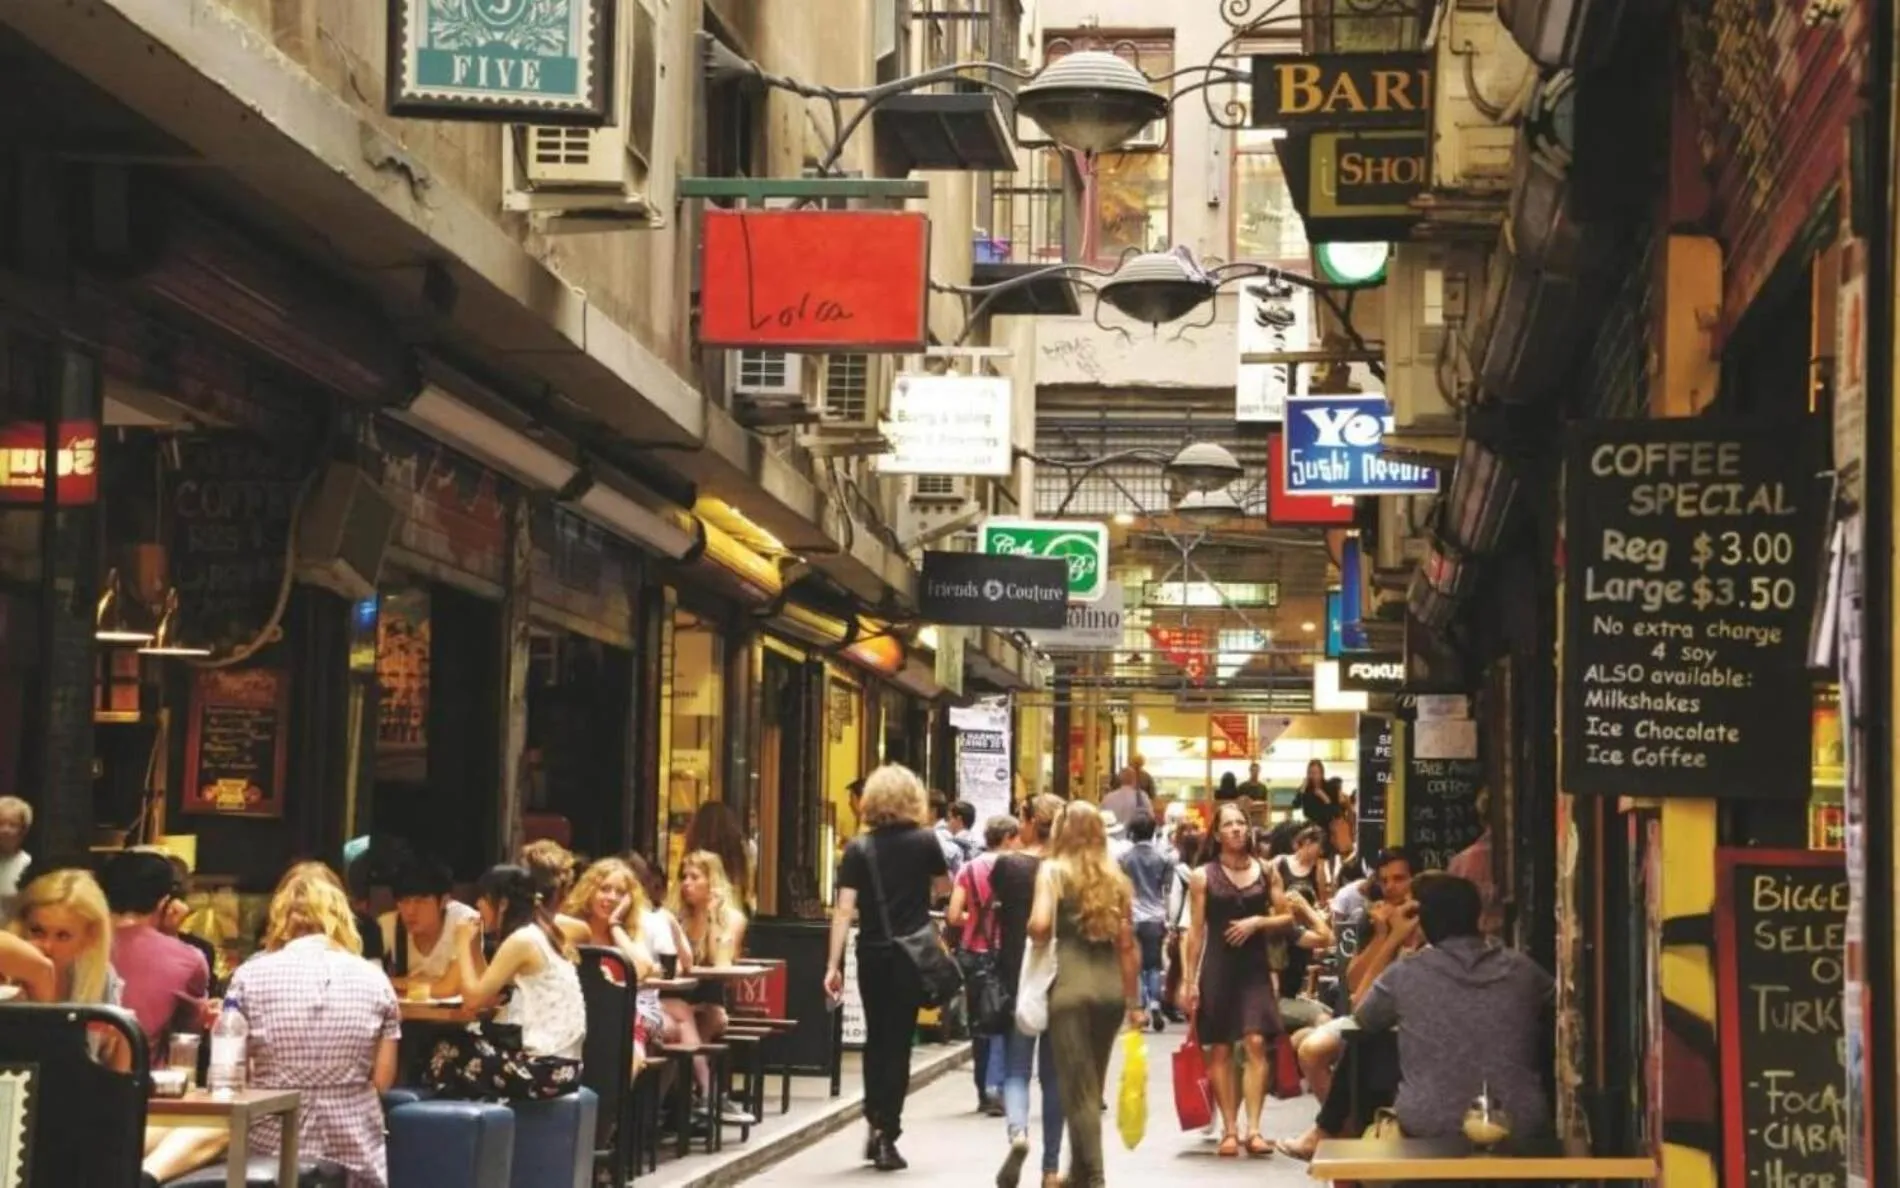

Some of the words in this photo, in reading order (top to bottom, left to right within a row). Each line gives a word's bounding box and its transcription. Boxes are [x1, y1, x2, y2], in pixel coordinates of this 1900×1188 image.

[452, 54, 541, 89] FIVE
[1290, 449, 1350, 486] Sushi
[1590, 441, 1741, 477] COFFEE
[1628, 482, 1797, 518] SPECIAL
[1602, 528, 1669, 572] Reg
[928, 579, 979, 597] Friends
[1006, 582, 1063, 604] Couture
[1586, 566, 1686, 612] Large
[1691, 574, 1796, 612] $3.50
[1593, 615, 1624, 636] No
[1633, 621, 1694, 638] extra
[1706, 619, 1782, 647] charge
[1651, 642, 1666, 661] 4
[1681, 647, 1717, 669] soy
[1584, 664, 1644, 684] ALSO
[1651, 667, 1753, 688] available:
[1585, 689, 1700, 714] Milkshakes
[1585, 716, 1623, 738] Ice
[1634, 720, 1740, 743] Chocolate
[1586, 744, 1624, 766] Ice
[1632, 746, 1707, 768] Coffee
[1749, 984, 1846, 1034] TURK
